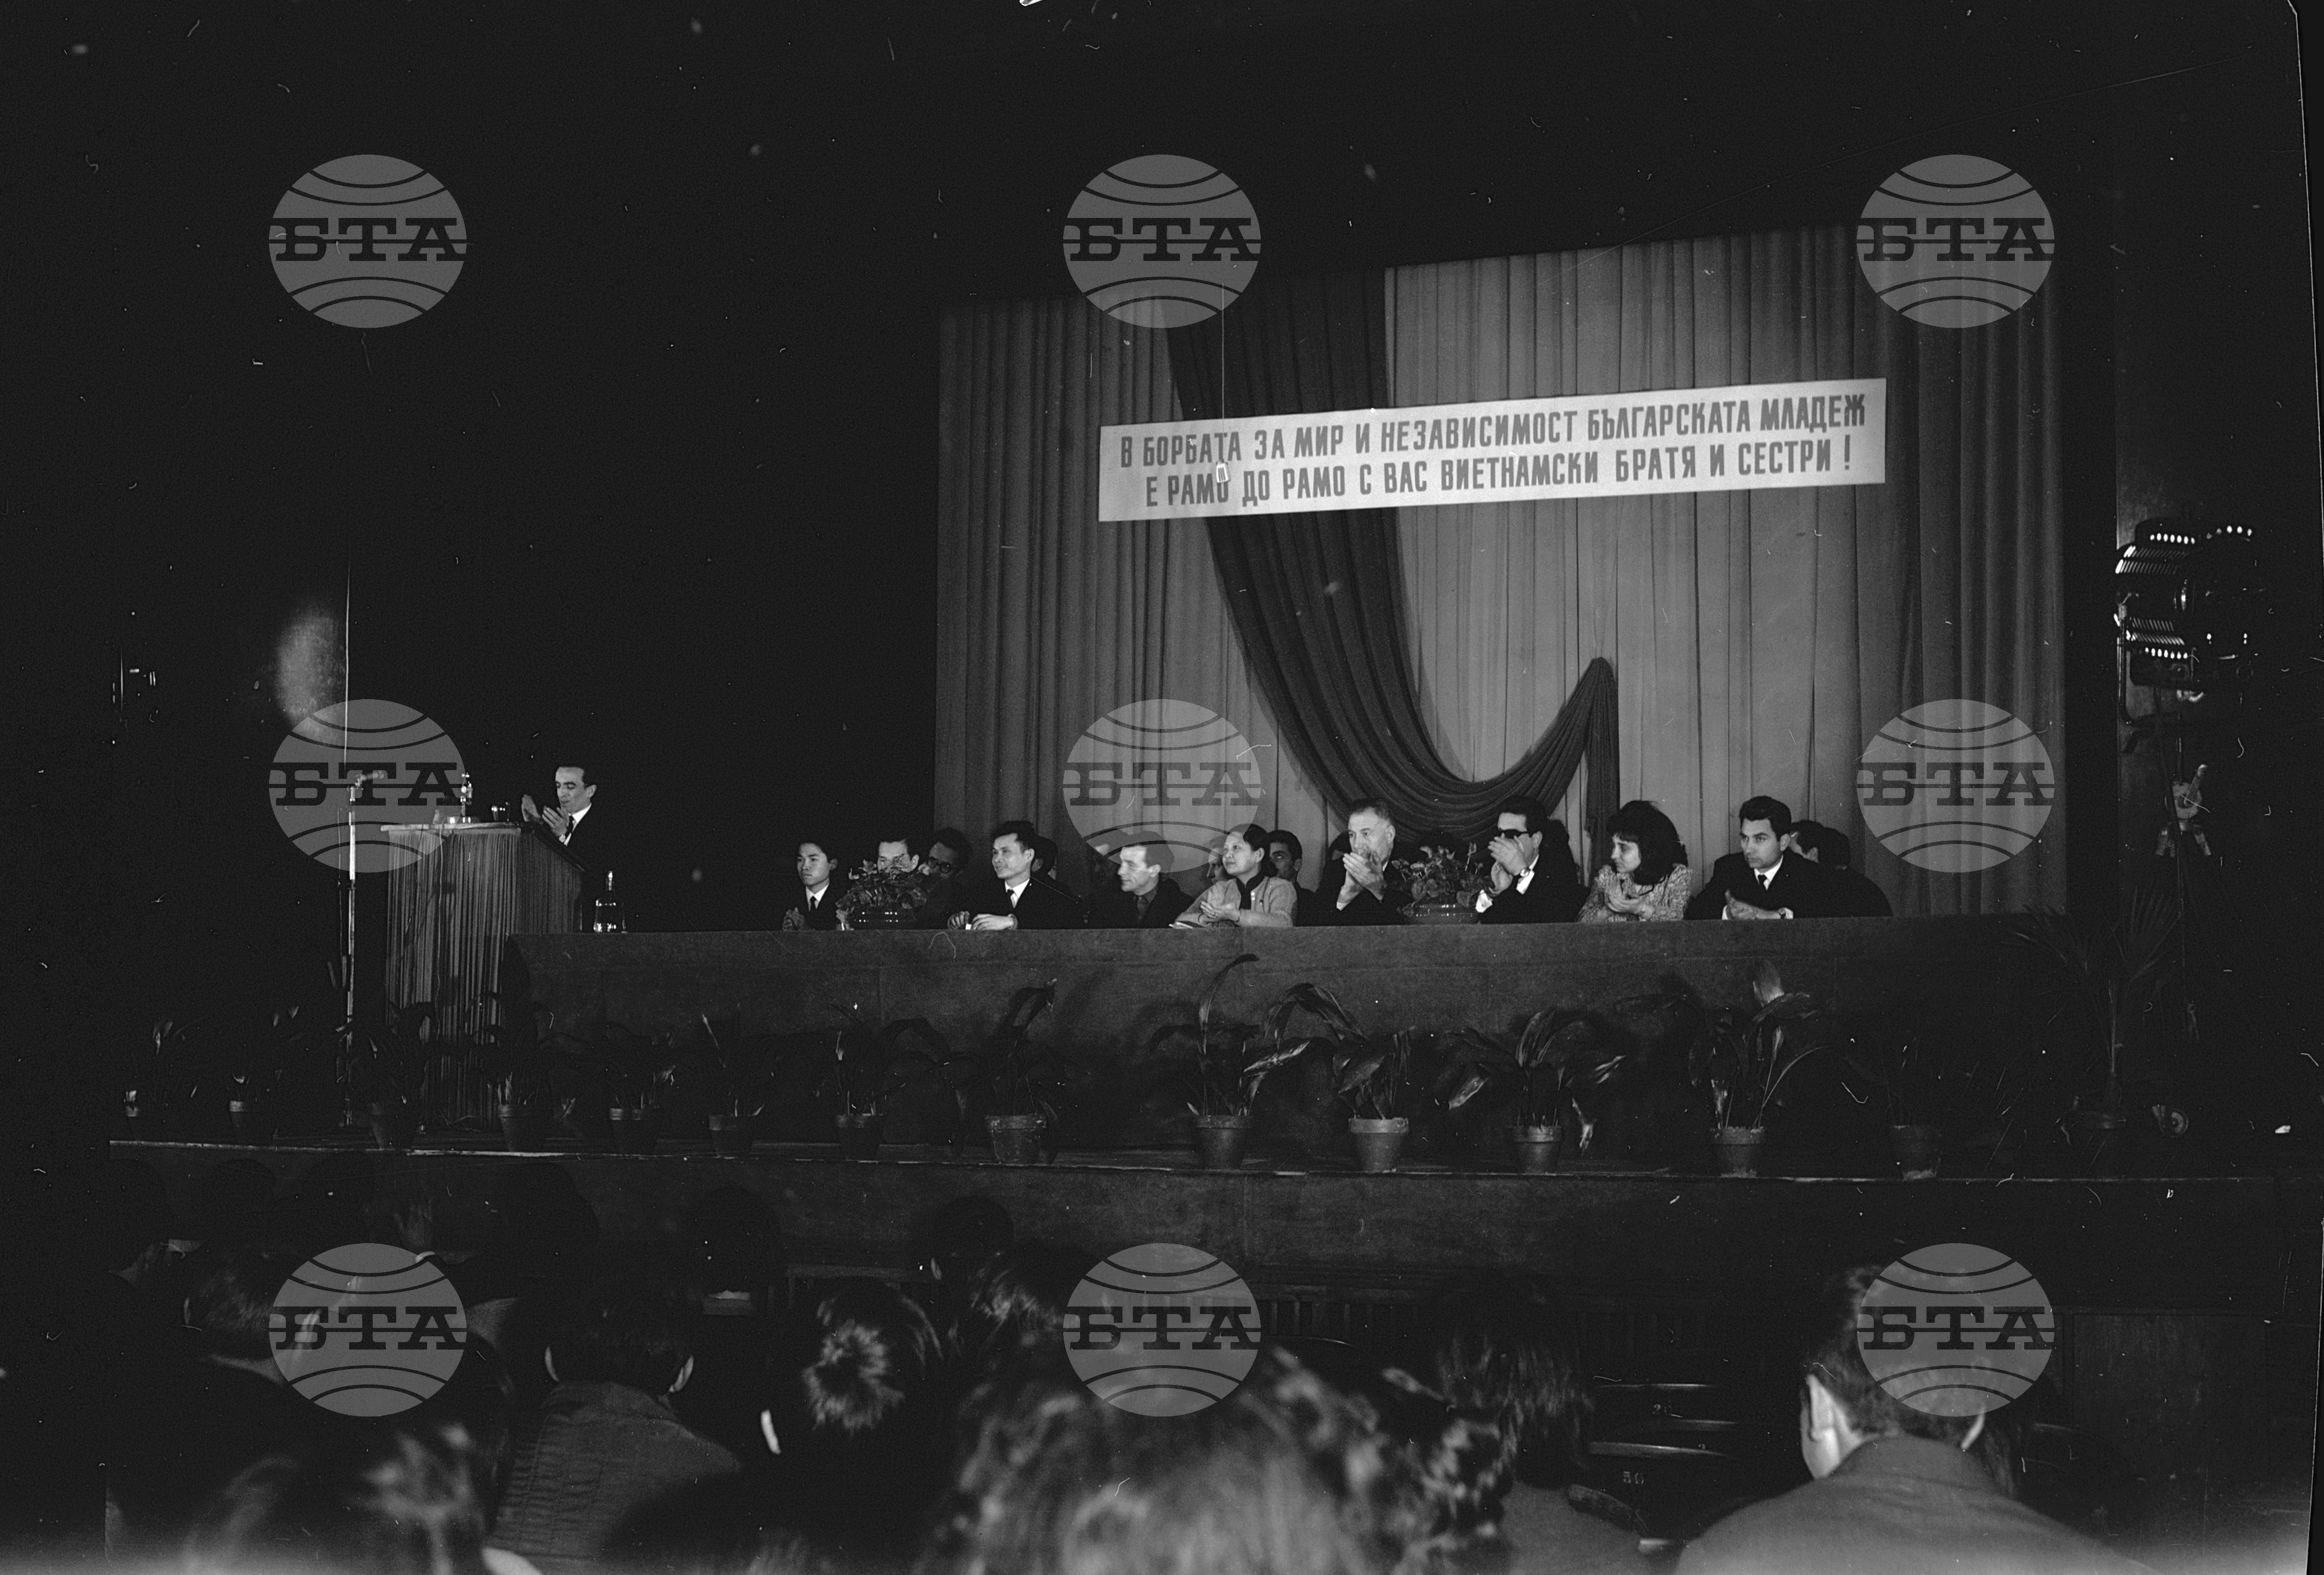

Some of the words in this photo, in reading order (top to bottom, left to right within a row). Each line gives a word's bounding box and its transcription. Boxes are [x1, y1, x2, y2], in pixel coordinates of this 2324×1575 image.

[1121, 436, 1132, 467] В
[1143, 432, 1240, 467] БОРБАТА
[1254, 429, 1285, 460] ЗА
[1294, 425, 1343, 458] МИР
[1356, 424, 1370, 454] И
[1381, 411, 1577, 452] НЕЗАВИСИМОСТ
[1588, 400, 1750, 441] БЪЛГАРСКАТА
[1760, 395, 1865, 433] МЛАДЕЖ
[1146, 476, 1157, 506] Е
[1168, 471, 1228, 505] РАМО
[1242, 471, 1269, 507] ДО
[1283, 466, 1345, 499] РАМО
[1360, 464, 1371, 495] С
[1384, 462, 1427, 493] ВАС
[1441, 452, 1598, 491] ВИЕТНАМСКИ
[1616, 446, 1695, 482] БРАТЯ
[1710, 445, 1724, 477] И
